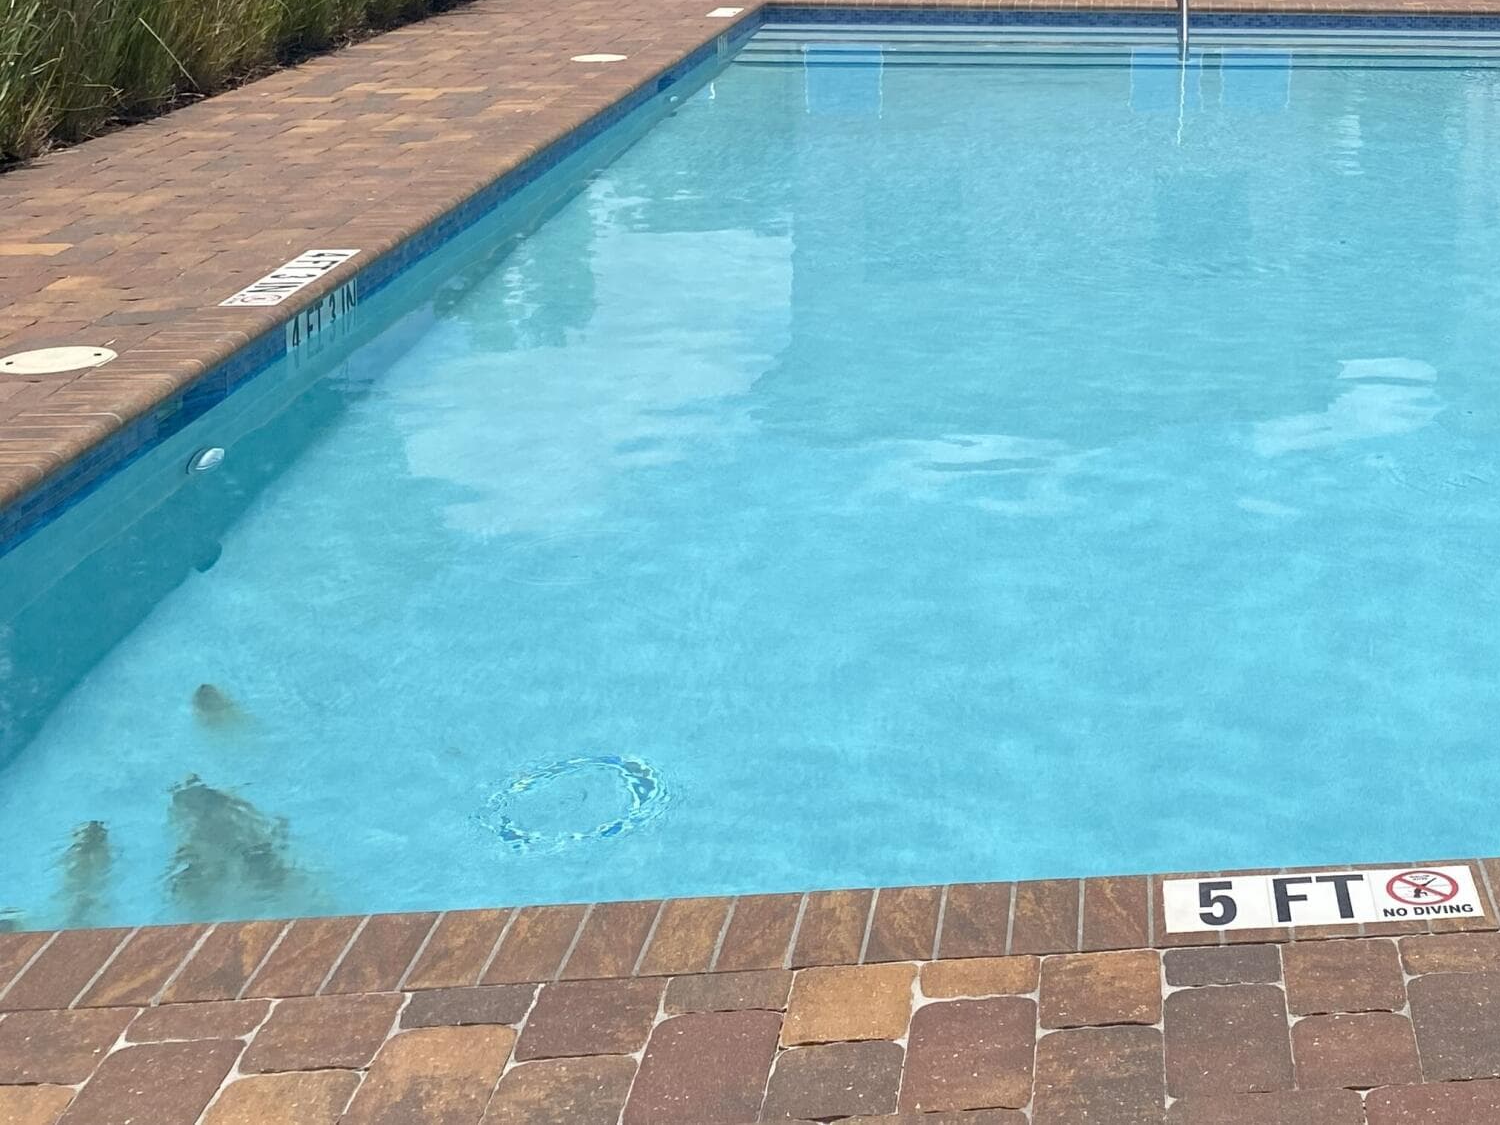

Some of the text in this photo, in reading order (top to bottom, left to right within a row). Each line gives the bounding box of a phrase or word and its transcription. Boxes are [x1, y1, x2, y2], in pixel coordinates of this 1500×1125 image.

[292, 279, 357, 347] 4 FT 3 IN
[1198, 874, 1364, 926] 5 FT
[1383, 903, 1474, 917] NO DIVING
